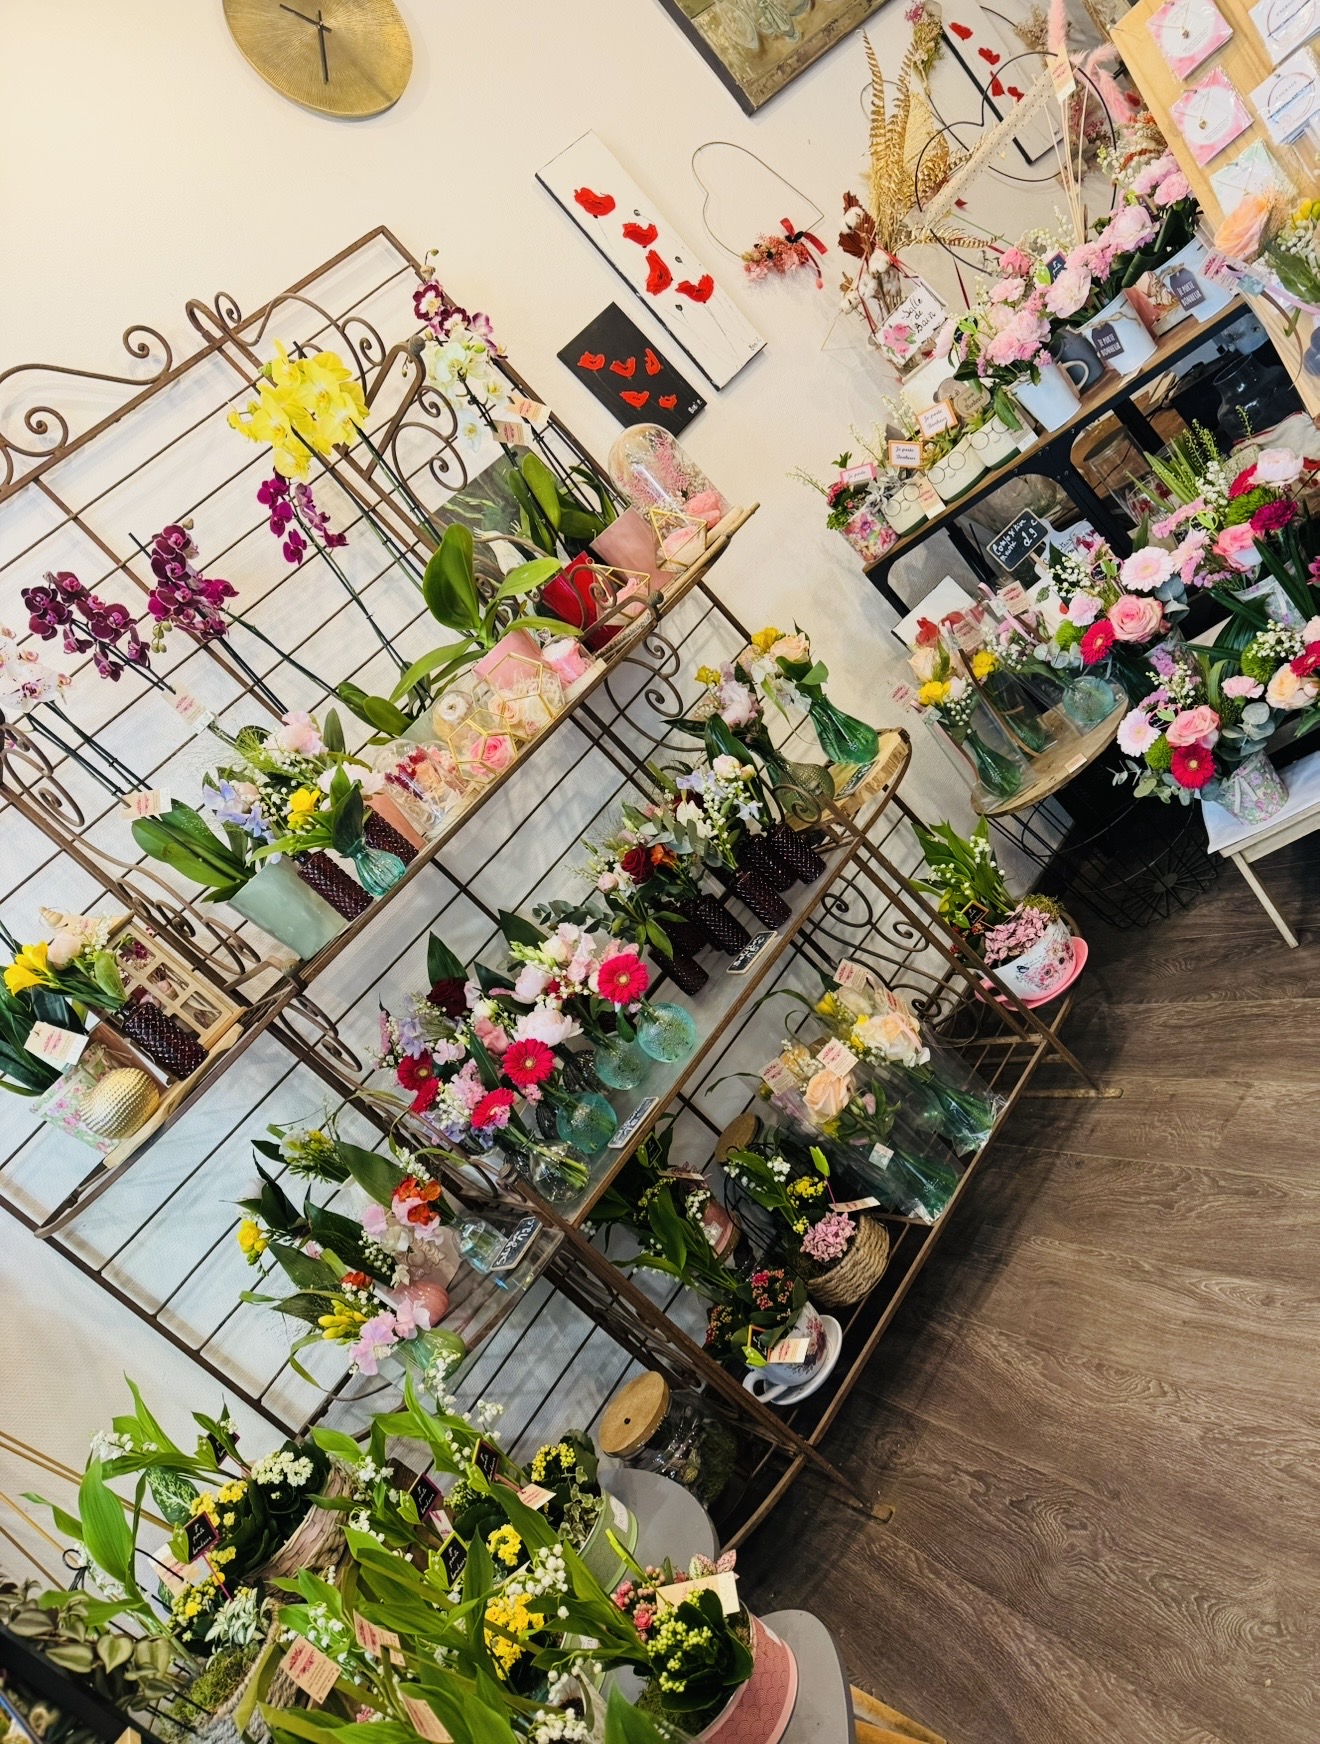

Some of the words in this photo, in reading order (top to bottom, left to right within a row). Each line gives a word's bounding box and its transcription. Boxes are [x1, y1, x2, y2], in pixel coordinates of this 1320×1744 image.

[1182, 281, 1195, 294] PORTE
[1181, 290, 1203, 307] BONHEUR
[1103, 333, 1116, 345] PORTE
[1101, 342, 1121, 357] BONHEUR
